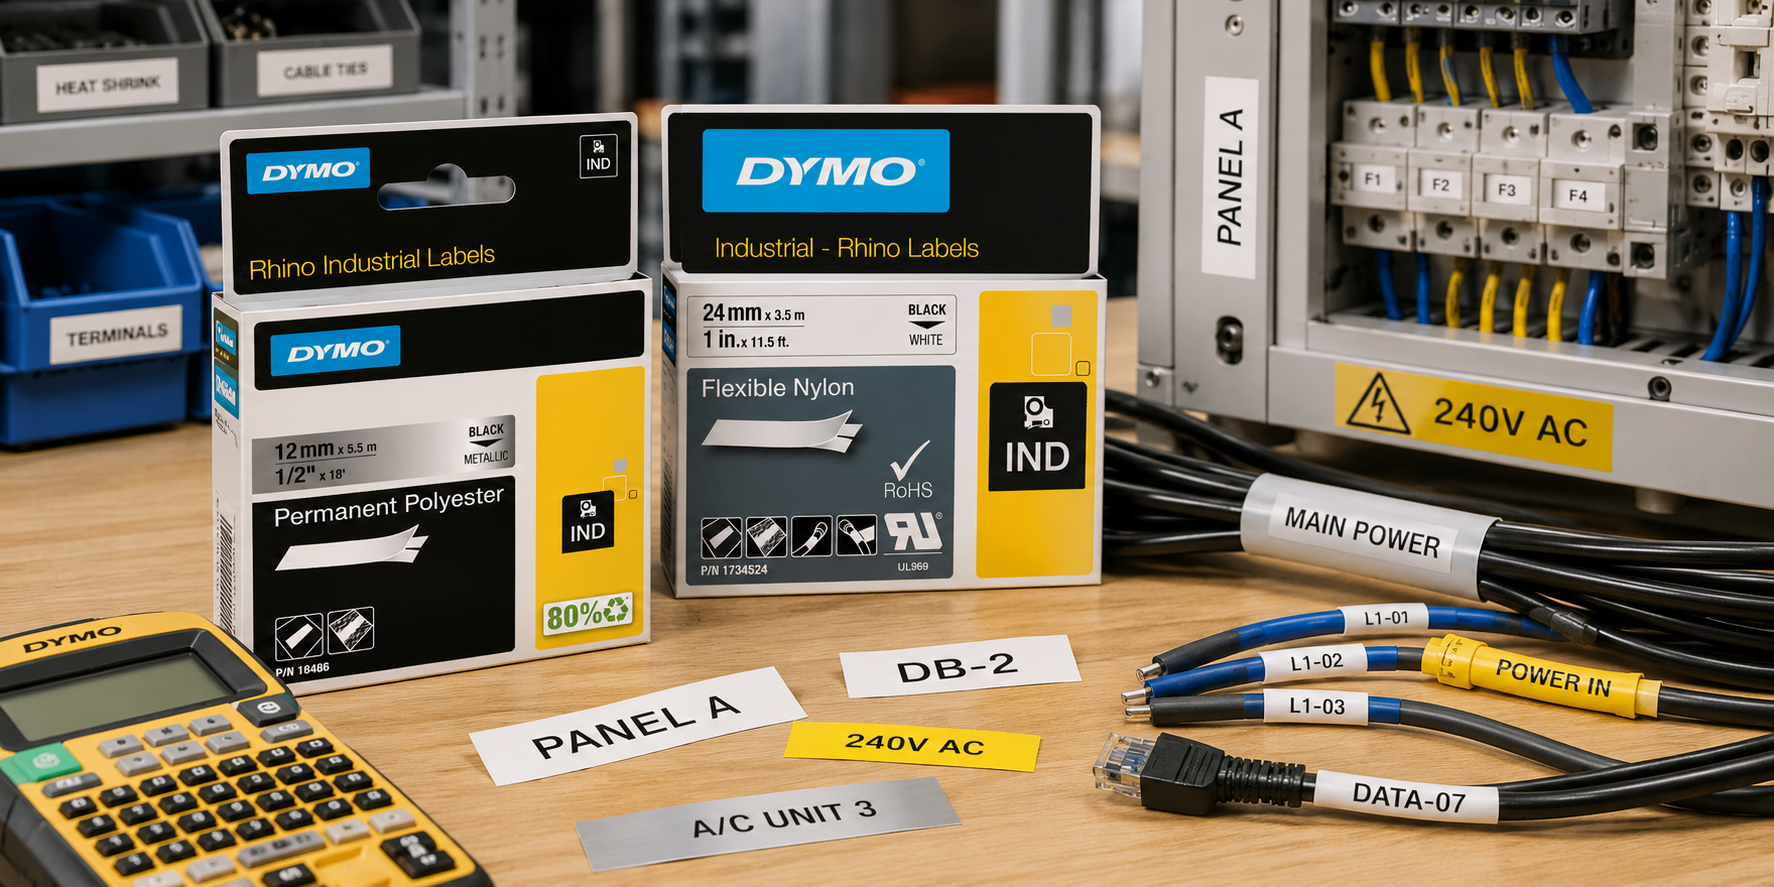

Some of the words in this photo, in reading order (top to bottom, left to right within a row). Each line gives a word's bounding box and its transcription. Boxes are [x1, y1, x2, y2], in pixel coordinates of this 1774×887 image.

[284, 64, 331, 80] CABLE
[336, 62, 368, 77] TIES
[56, 80, 97, 96] HEAT
[102, 75, 161, 93] SHRINK
[1219, 108, 1244, 131] A
[586, 157, 611, 171] IND
[1365, 172, 1381, 186] F1
[1433, 178, 1450, 192] F2
[1217, 141, 1244, 247] PANEL
[1499, 183, 1517, 197] F3
[1569, 189, 1588, 203] F4
[715, 237, 814, 258] Industrial
[838, 237, 900, 258] Rhino
[908, 237, 979, 258] Labels
[249, 258, 316, 281] Rhino
[323, 249, 420, 275] Industrial
[428, 244, 496, 268] Labels
[765, 312, 772, 320] x
[774, 310, 792, 320] 3.5
[794, 311, 805, 320] m
[908, 304, 947, 315] BLACK
[67, 323, 168, 347] TERMINALS
[703, 330, 713, 348] 1
[751, 336, 775, 348] 11.5
[777, 336, 789, 347] ft.
[909, 334, 943, 346] WHITE
[702, 379, 787, 397] Flexible
[794, 379, 854, 400] Nylon
[469, 423, 504, 437] BLACK
[1434, 398, 1525, 436] 240V
[1537, 414, 1588, 448] AC
[338, 447, 345, 455] x
[347, 443, 364, 454] 5.5
[366, 444, 377, 453] m
[464, 450, 509, 465] METALLIC
[1006, 442, 1070, 473] IND
[275, 465, 316, 486] 1/2"
[319, 472, 327, 481] x
[329, 469, 346, 480] 18'
[884, 482, 933, 498] RoHS
[274, 498, 398, 528] Permanent
[405, 487, 505, 514] Polyester
[570, 523, 606, 542] IND
[1285, 507, 1348, 539] MAIN
[1353, 520, 1441, 558] POWER
[700, 565, 719, 576] P/N
[722, 564, 768, 575] 1734524
[897, 562, 929, 571] UL969
[547, 601, 603, 631] 80%
[1364, 610, 1409, 626] L1-01
[23, 626, 122, 654] DYMO
[275, 666, 295, 678] P/N
[297, 663, 330, 676] 18486
[897, 652, 1020, 683] DB-2
[1290, 653, 1343, 671] L1-02
[1495, 658, 1580, 693] POWER
[1587, 677, 1612, 698] IN
[1289, 697, 1346, 716] L1-03
[532, 704, 697, 760] PANEL
[708, 695, 742, 720] A
[845, 732, 930, 753] 240V
[938, 740, 986, 756] AC
[1353, 782, 1466, 814] DATA-07
[693, 814, 755, 838] A/C
[762, 802, 843, 831] UNIT
[855, 799, 877, 819] 3
